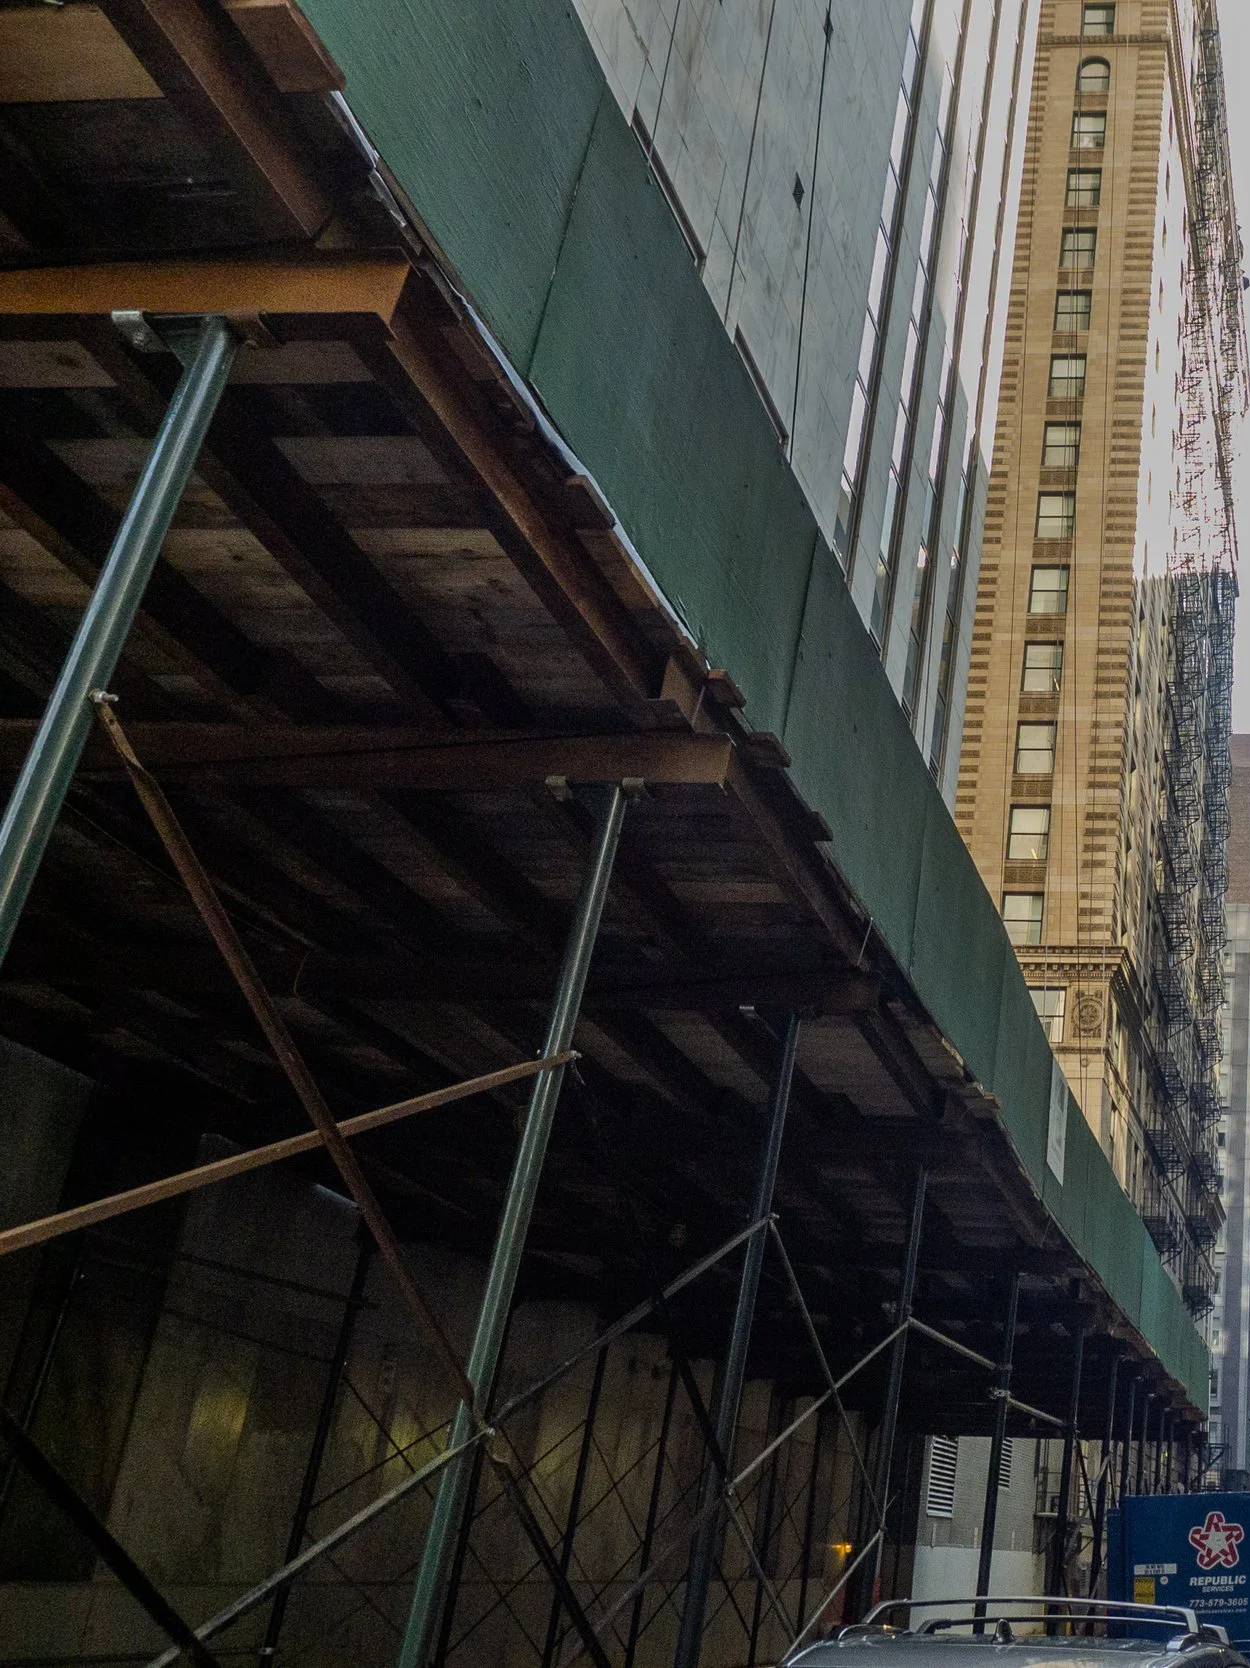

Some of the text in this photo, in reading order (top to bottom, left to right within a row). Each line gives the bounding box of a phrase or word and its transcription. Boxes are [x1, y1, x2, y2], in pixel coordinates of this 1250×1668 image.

[1190, 1575, 1246, 1586] REPUBLIC
[1202, 1585, 1234, 1593] SERVICES
[1189, 1598, 1248, 1607] 773-579-3605
